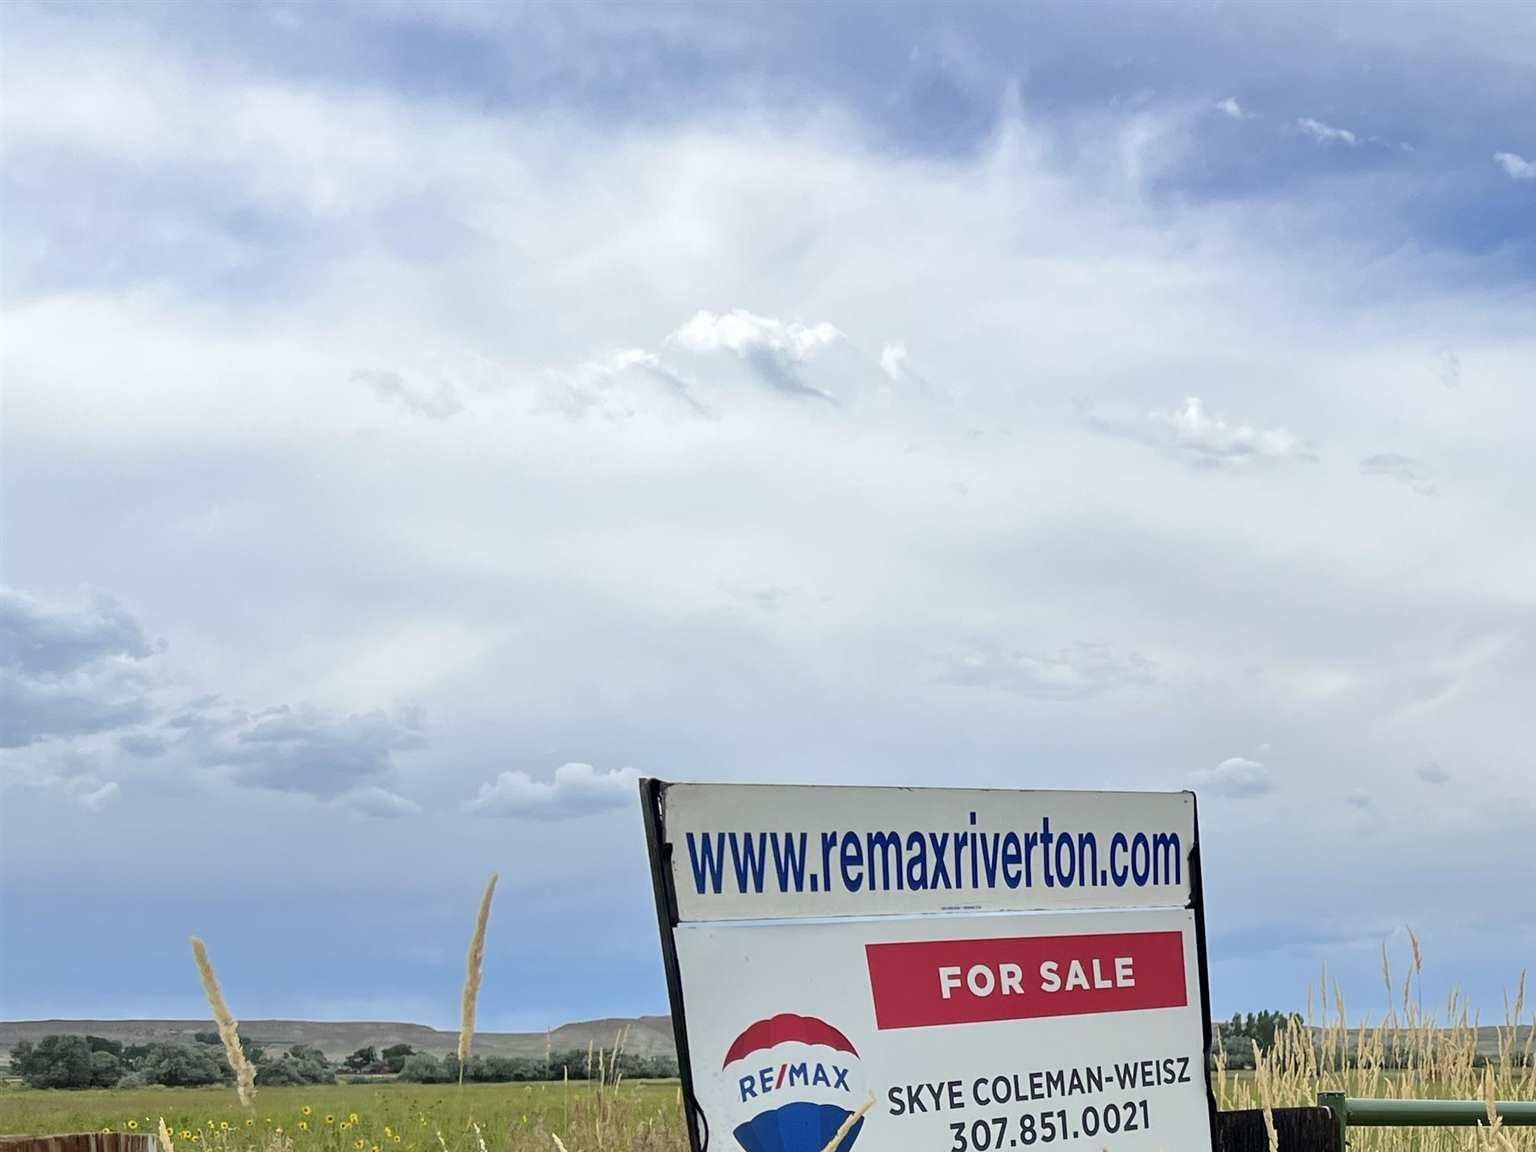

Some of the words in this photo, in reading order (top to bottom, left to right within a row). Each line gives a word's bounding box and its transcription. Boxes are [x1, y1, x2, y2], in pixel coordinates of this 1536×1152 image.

[685, 812, 1182, 894] www.remaxriverton.com
[938, 963, 1025, 1000] FOR
[1039, 956, 1136, 992] SALE
[739, 1062, 851, 1103] RE/MAX
[888, 1079, 966, 1116] SKYE
[972, 1056, 1191, 1107] COLEMAN-WEISZ
